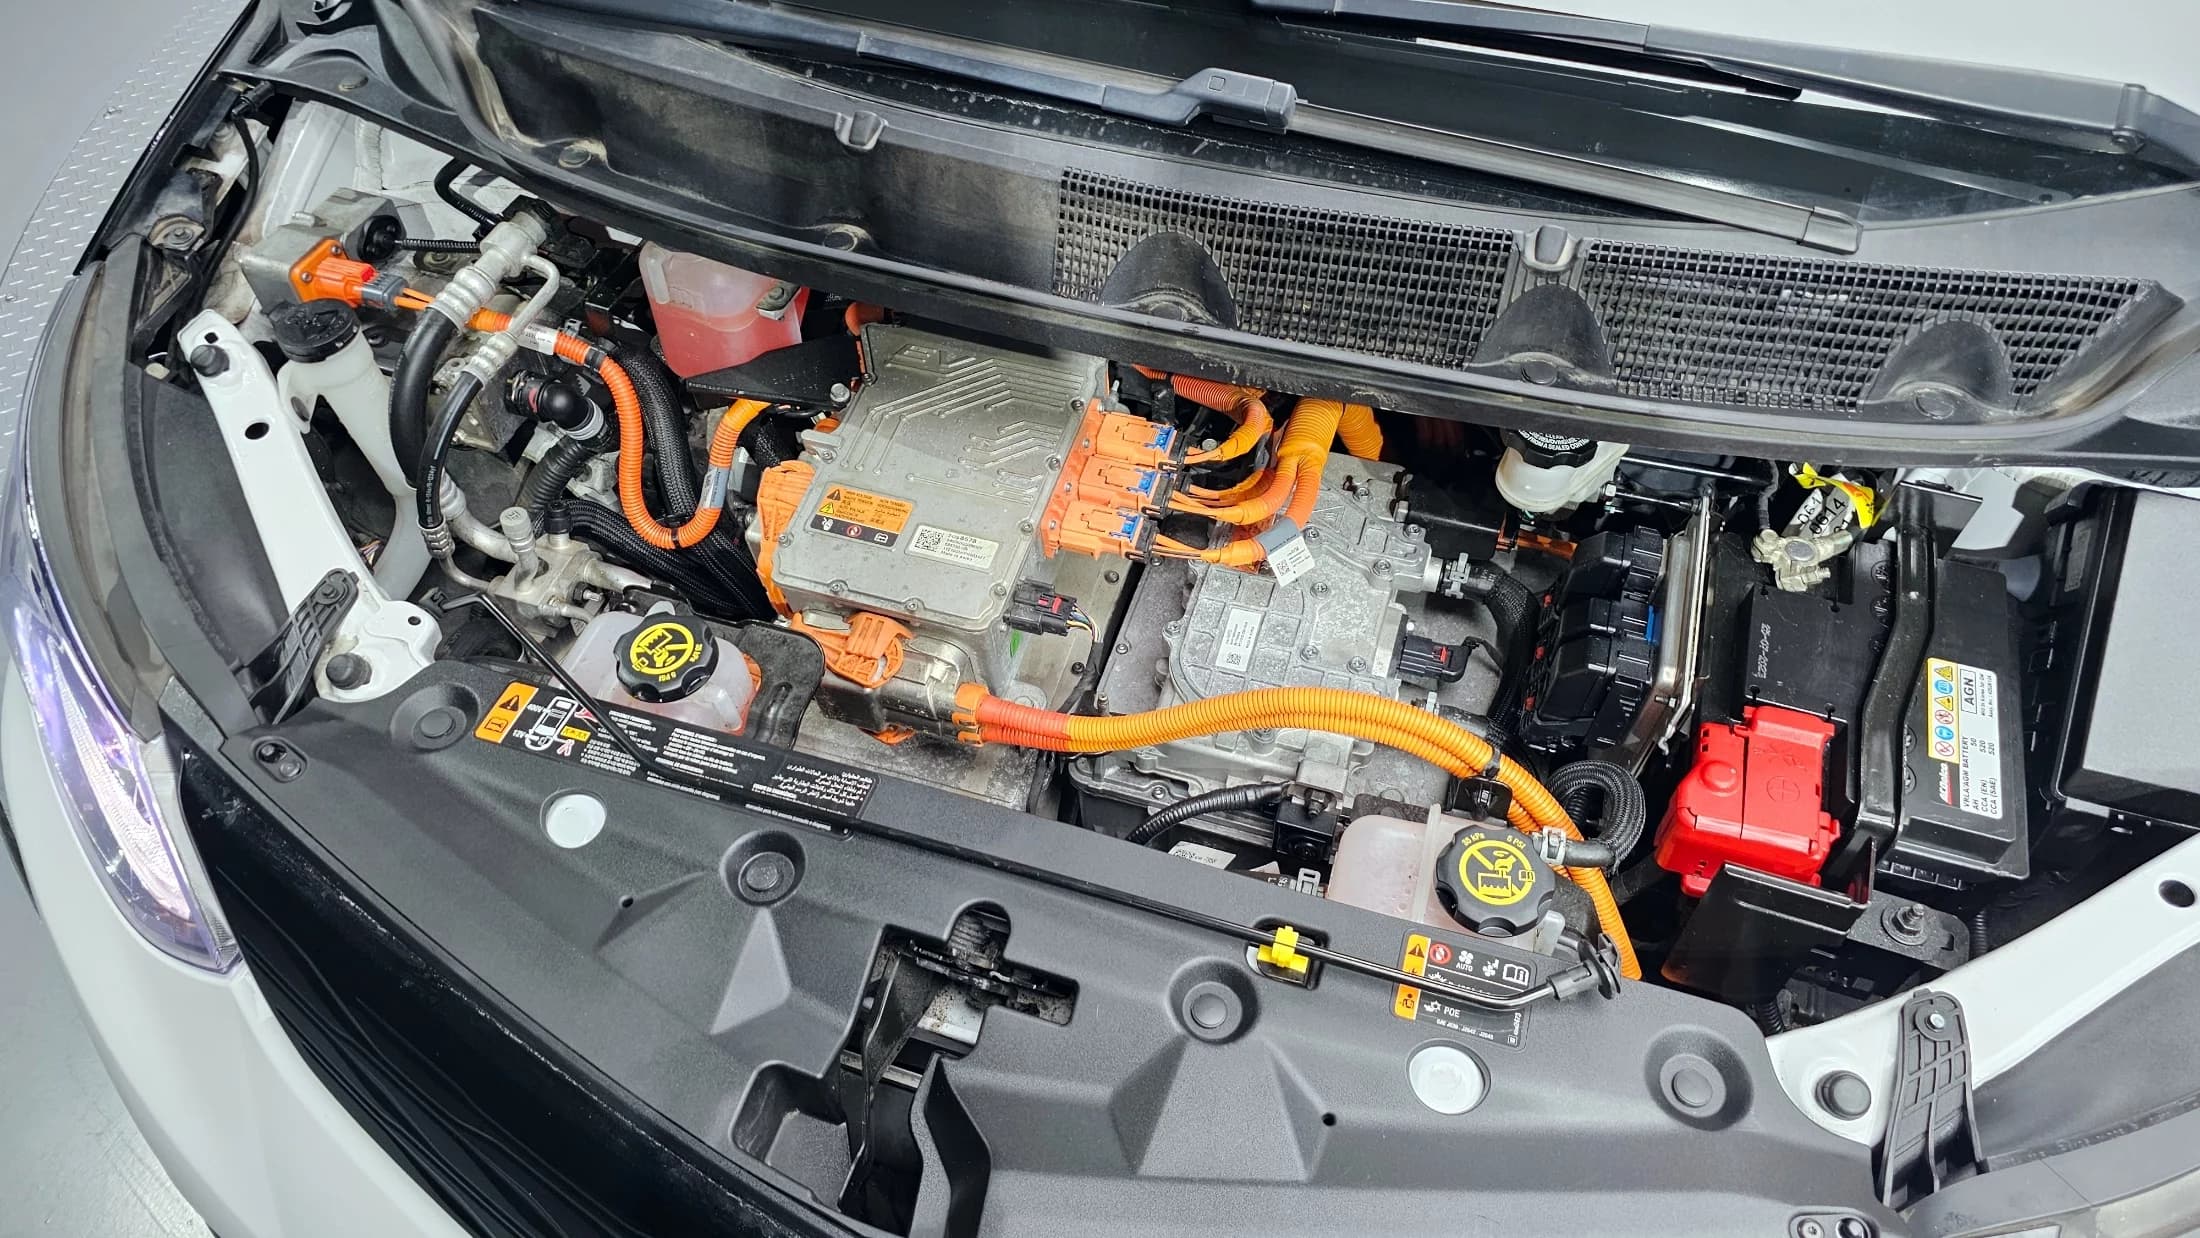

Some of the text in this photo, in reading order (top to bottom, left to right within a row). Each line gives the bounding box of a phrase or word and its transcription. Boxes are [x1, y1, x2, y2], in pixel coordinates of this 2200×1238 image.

[1961, 736, 1969, 768] BATTERY
[1970, 737, 1979, 811] AH 50
[1512, 839, 1527, 850] PSI
[1456, 962, 1473, 972] AUTO
[1443, 1006, 1461, 1018] POE
